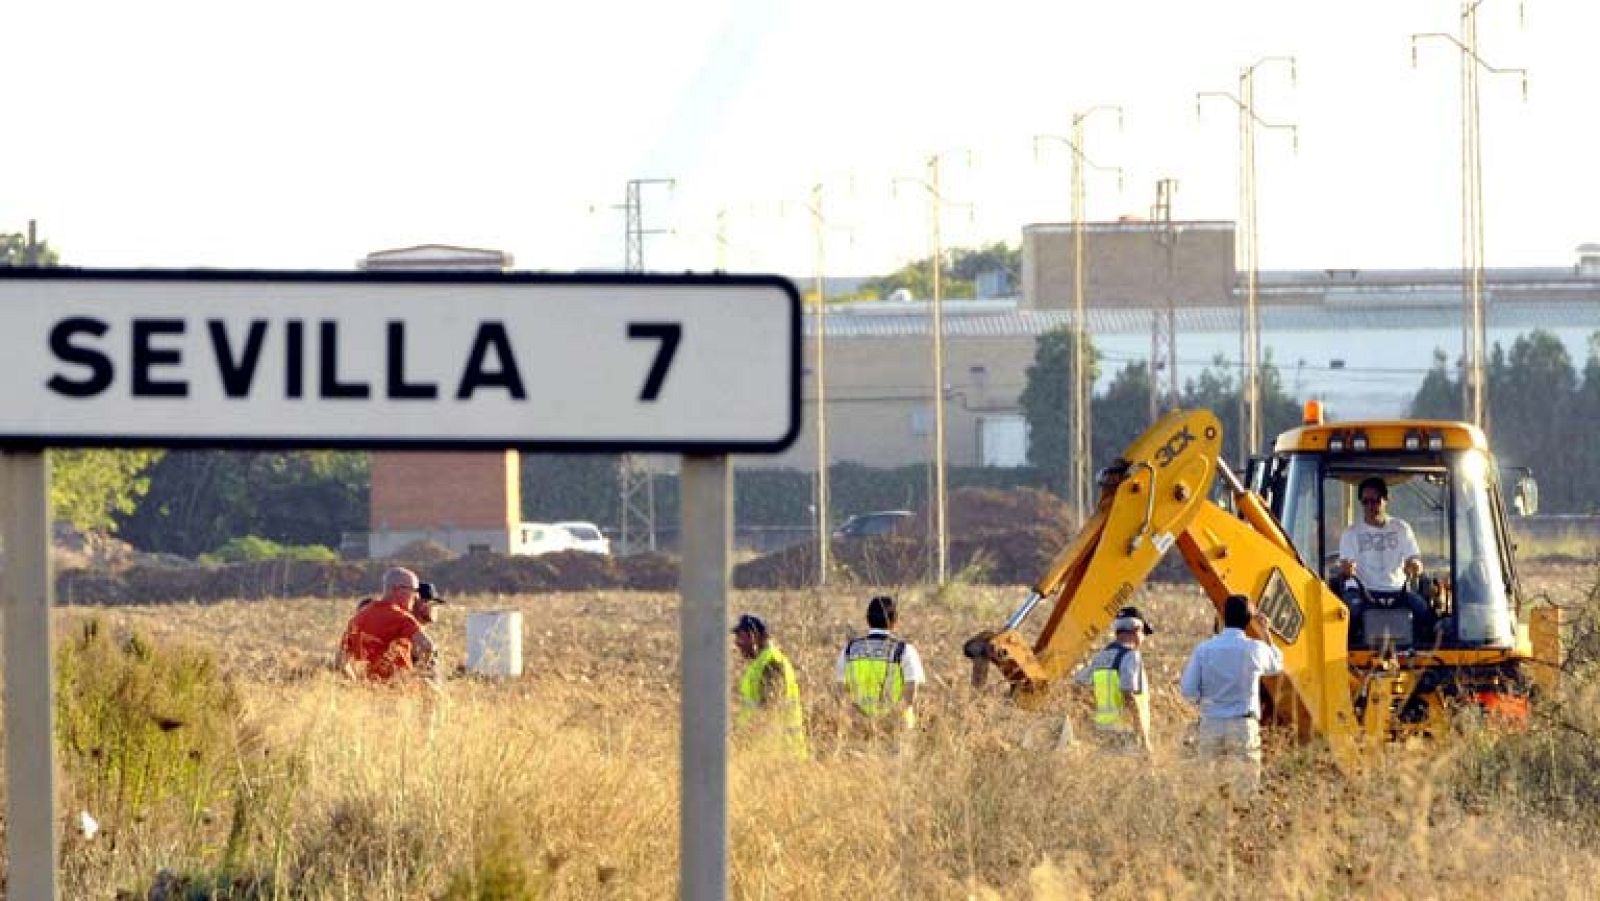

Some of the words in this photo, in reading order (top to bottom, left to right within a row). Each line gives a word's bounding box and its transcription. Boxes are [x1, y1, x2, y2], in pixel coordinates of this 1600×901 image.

[45, 315, 528, 401] SEVILLA
[626, 321, 683, 402] 7
[1154, 425, 1196, 467] 3CX
[1260, 579, 1300, 639] JCB
